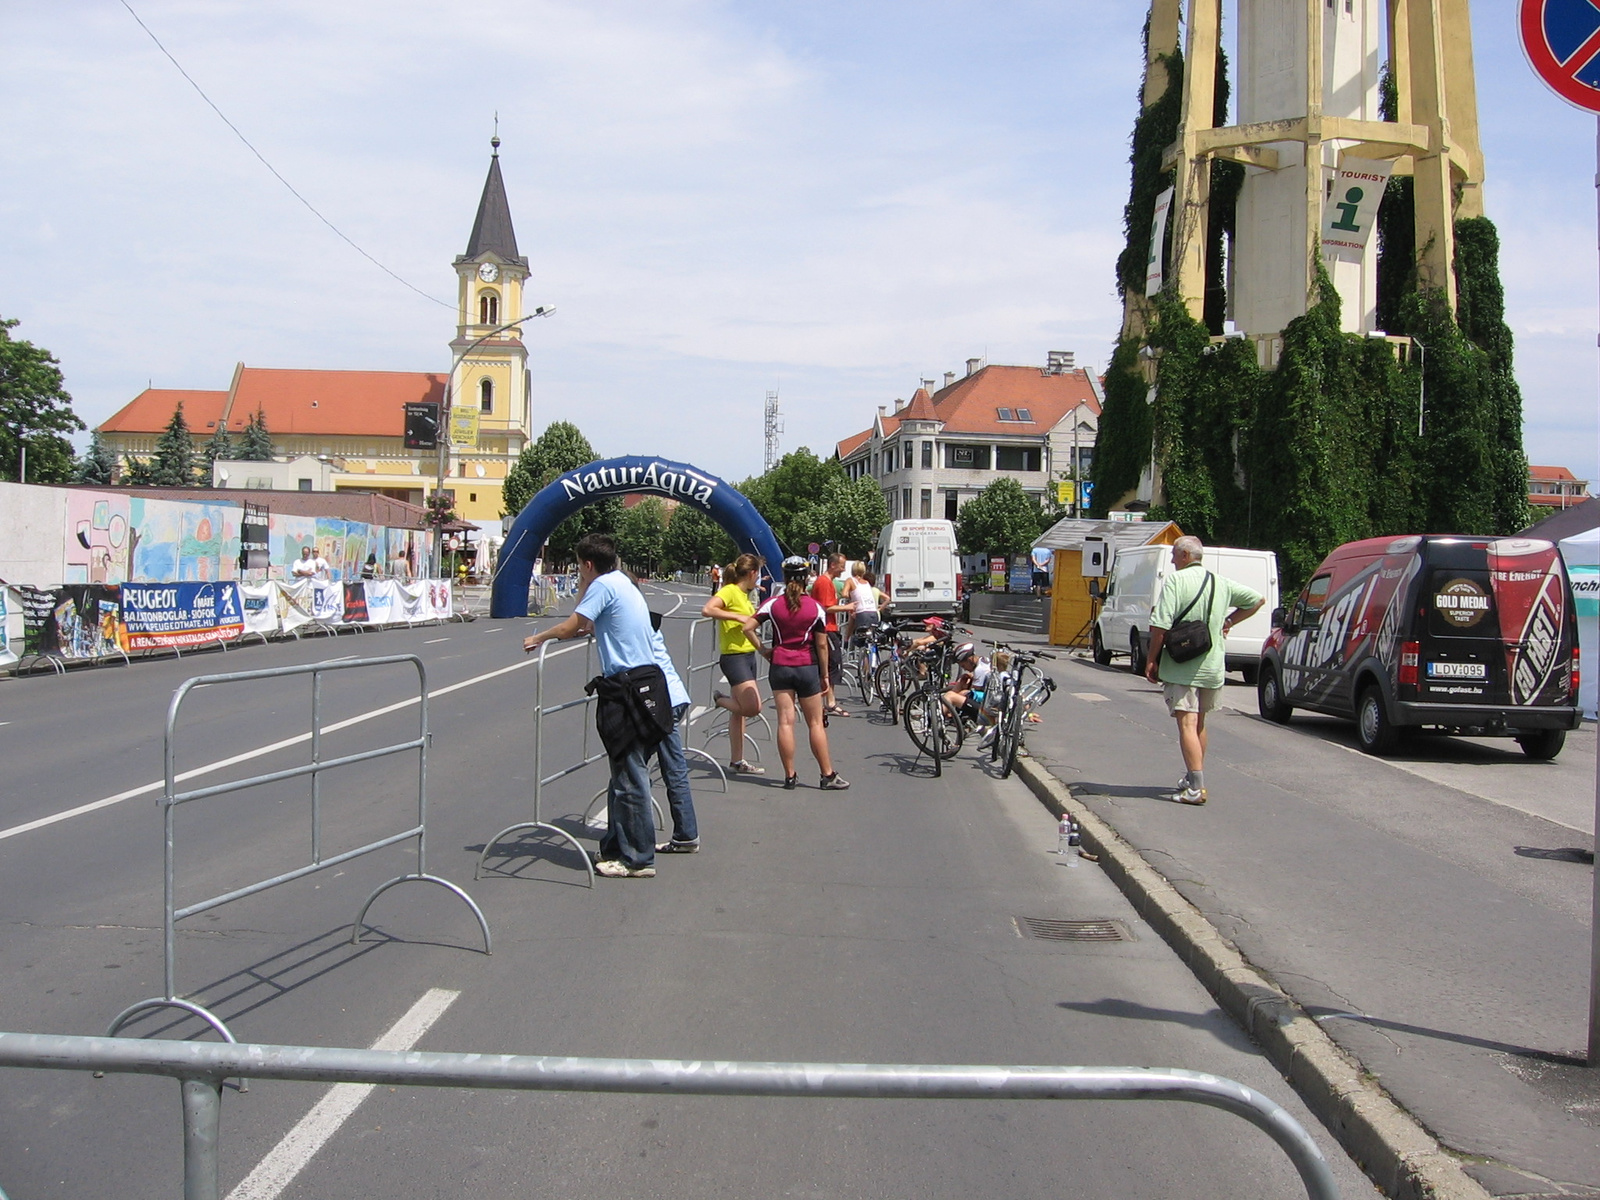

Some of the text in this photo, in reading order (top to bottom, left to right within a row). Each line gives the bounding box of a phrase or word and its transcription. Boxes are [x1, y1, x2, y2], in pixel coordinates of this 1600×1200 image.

[1341, 171, 1386, 183] TOURIST
[560, 461, 714, 506] NaturAqua
[1570, 579, 1600, 592] nch
[123, 588, 177, 609] PEUGEOT
[1436, 594, 1489, 610] GOLD MEDAL
[130, 637, 137, 648] A
[1515, 657, 1536, 701] GO
[1428, 685, 1483, 694] www.gofast.hu
